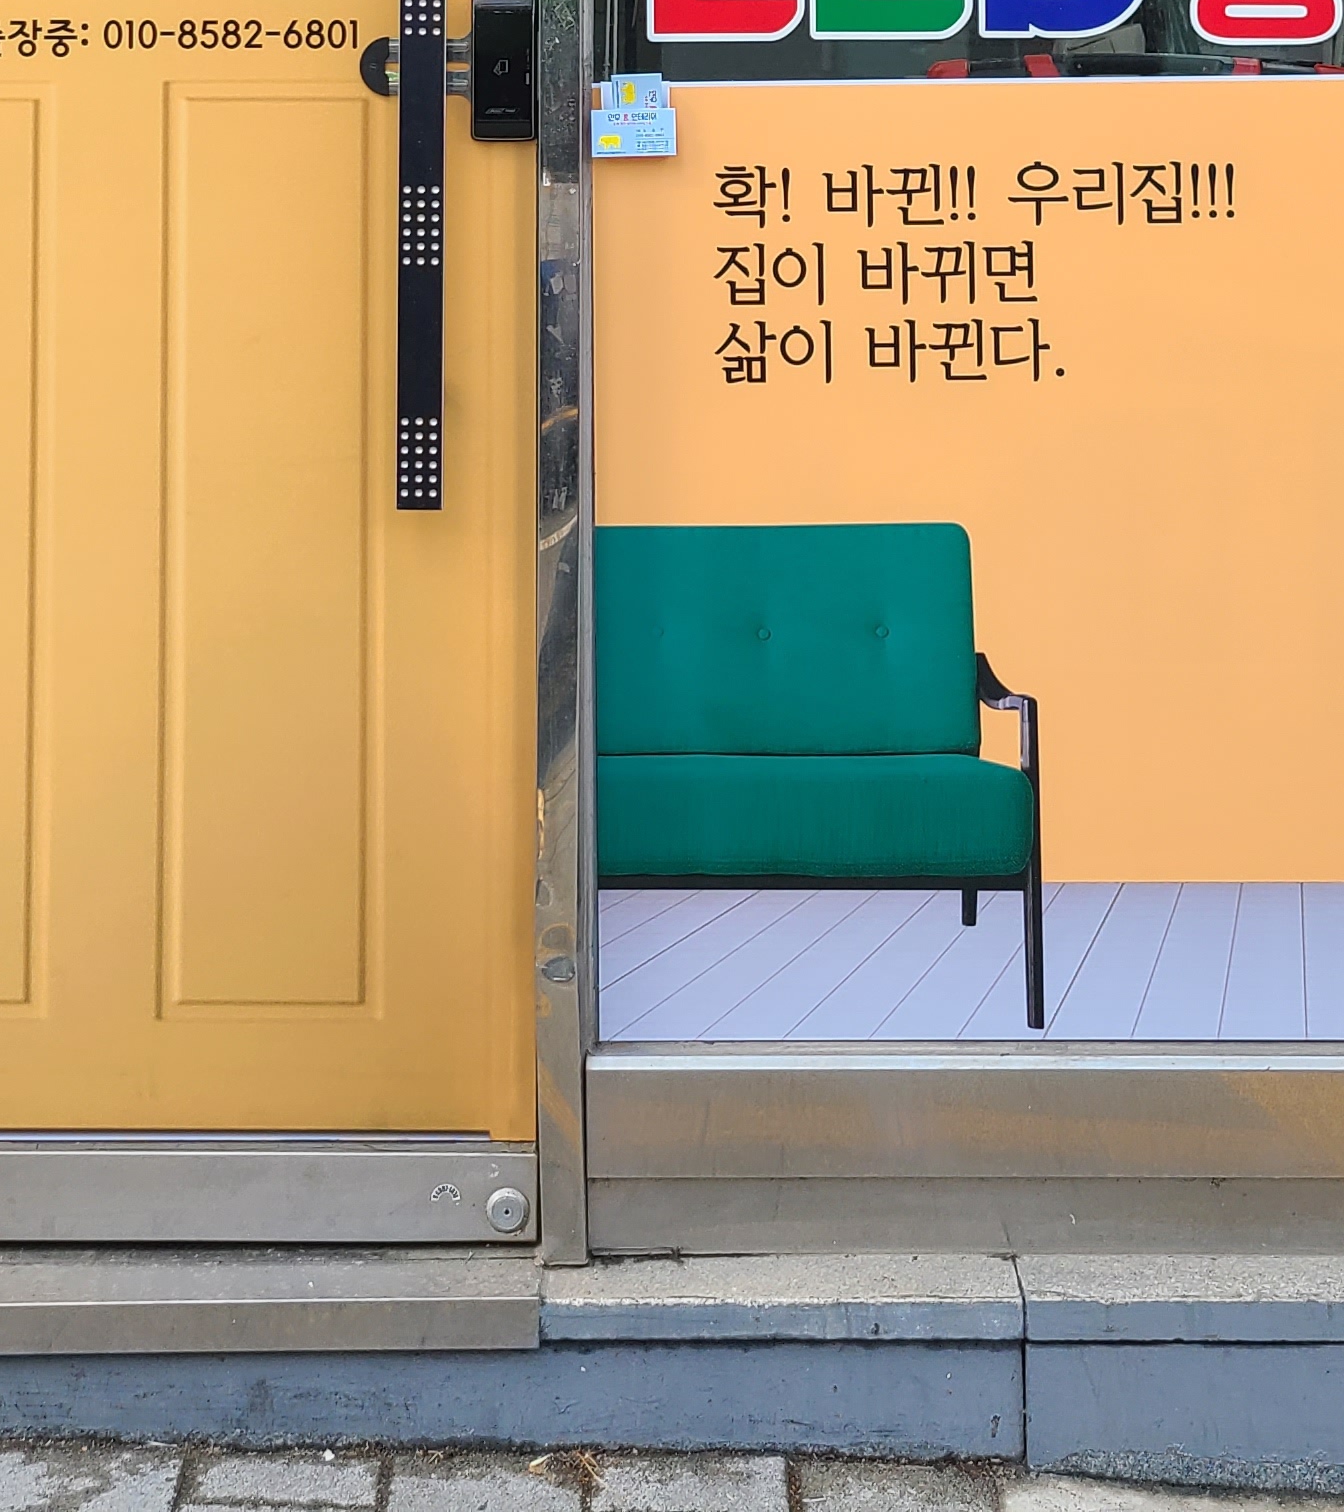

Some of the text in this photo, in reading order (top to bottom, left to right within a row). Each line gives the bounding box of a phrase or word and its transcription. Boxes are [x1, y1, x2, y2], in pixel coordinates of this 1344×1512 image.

[103, 19, 358, 50] 010-8582-6801
[714, 161, 1234, 228] 확! 바뀐!! 우리집!!!
[714, 241, 1037, 305] 집이 바뀌면
[714, 318, 1065, 383] 삶이 바뀐다.
